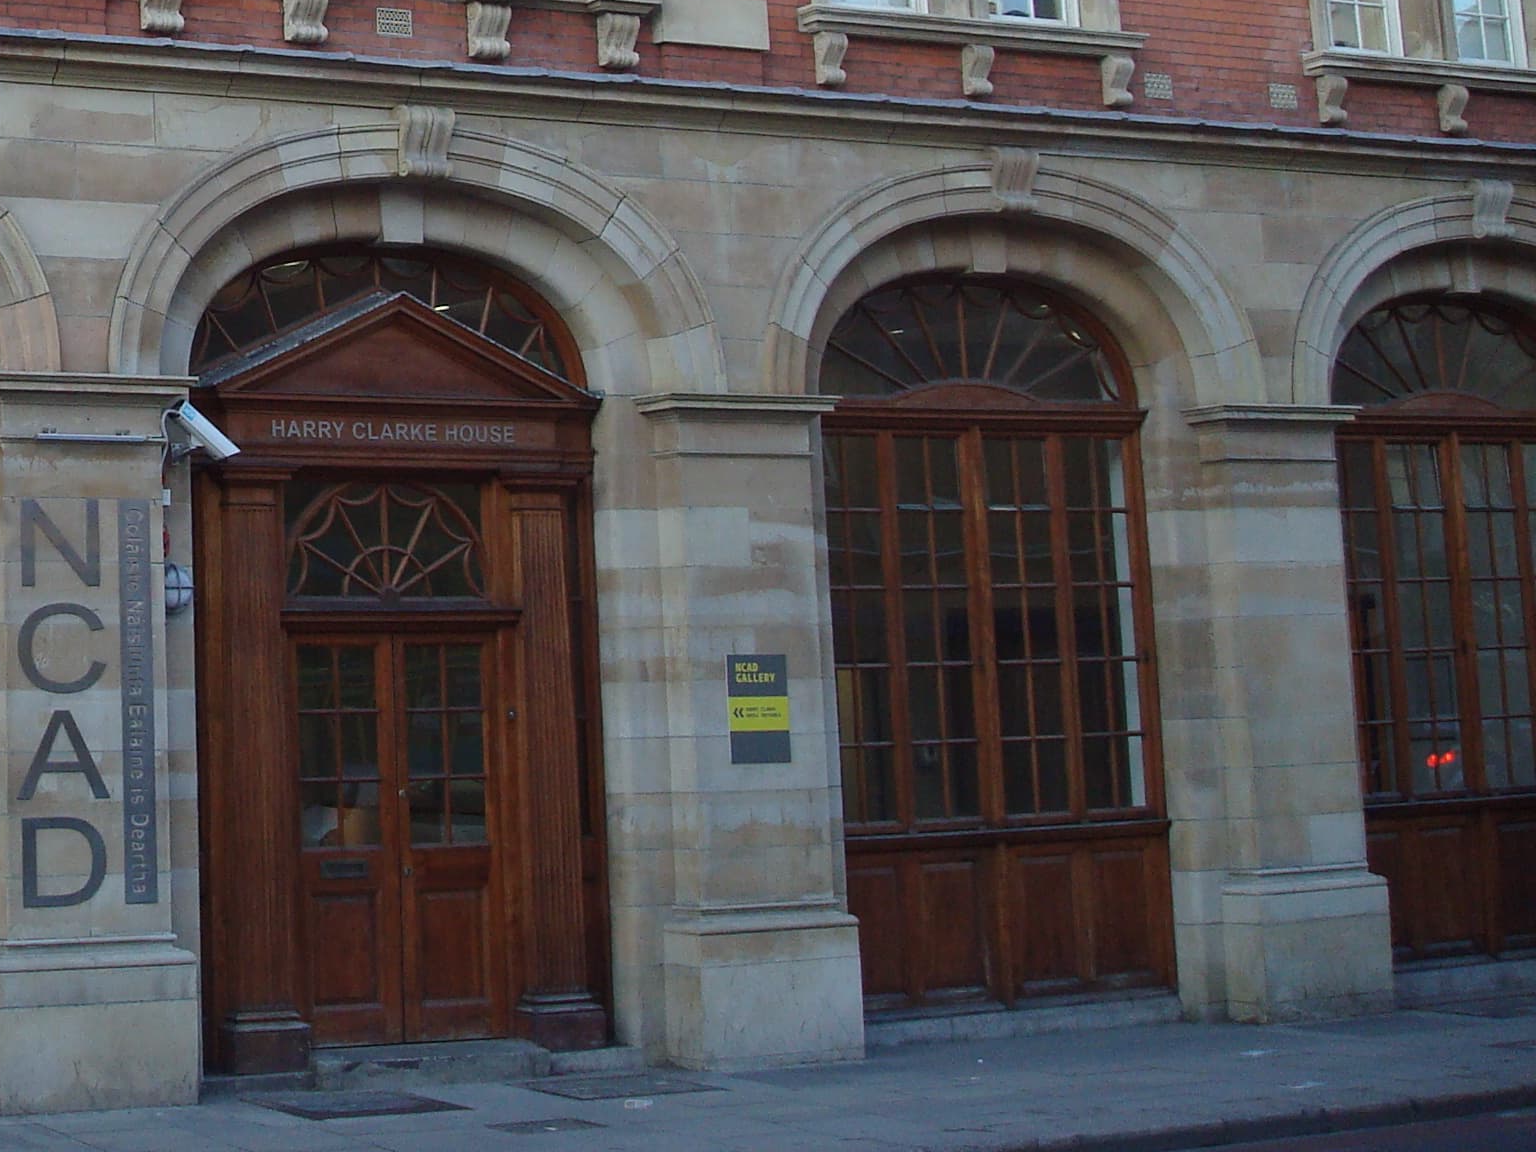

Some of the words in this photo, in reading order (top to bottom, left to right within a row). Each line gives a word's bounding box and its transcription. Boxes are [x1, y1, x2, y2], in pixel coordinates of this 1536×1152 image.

[271, 419, 345, 440] HARRY
[351, 421, 437, 442] CLARKE
[445, 423, 516, 444] HOUSE
[735, 662, 759, 673] NCAD
[735, 673, 776, 683] GALLERY
[17, 499, 110, 909] NCAD
[131, 788, 148, 805] is
[131, 813, 150, 894] Deartha
